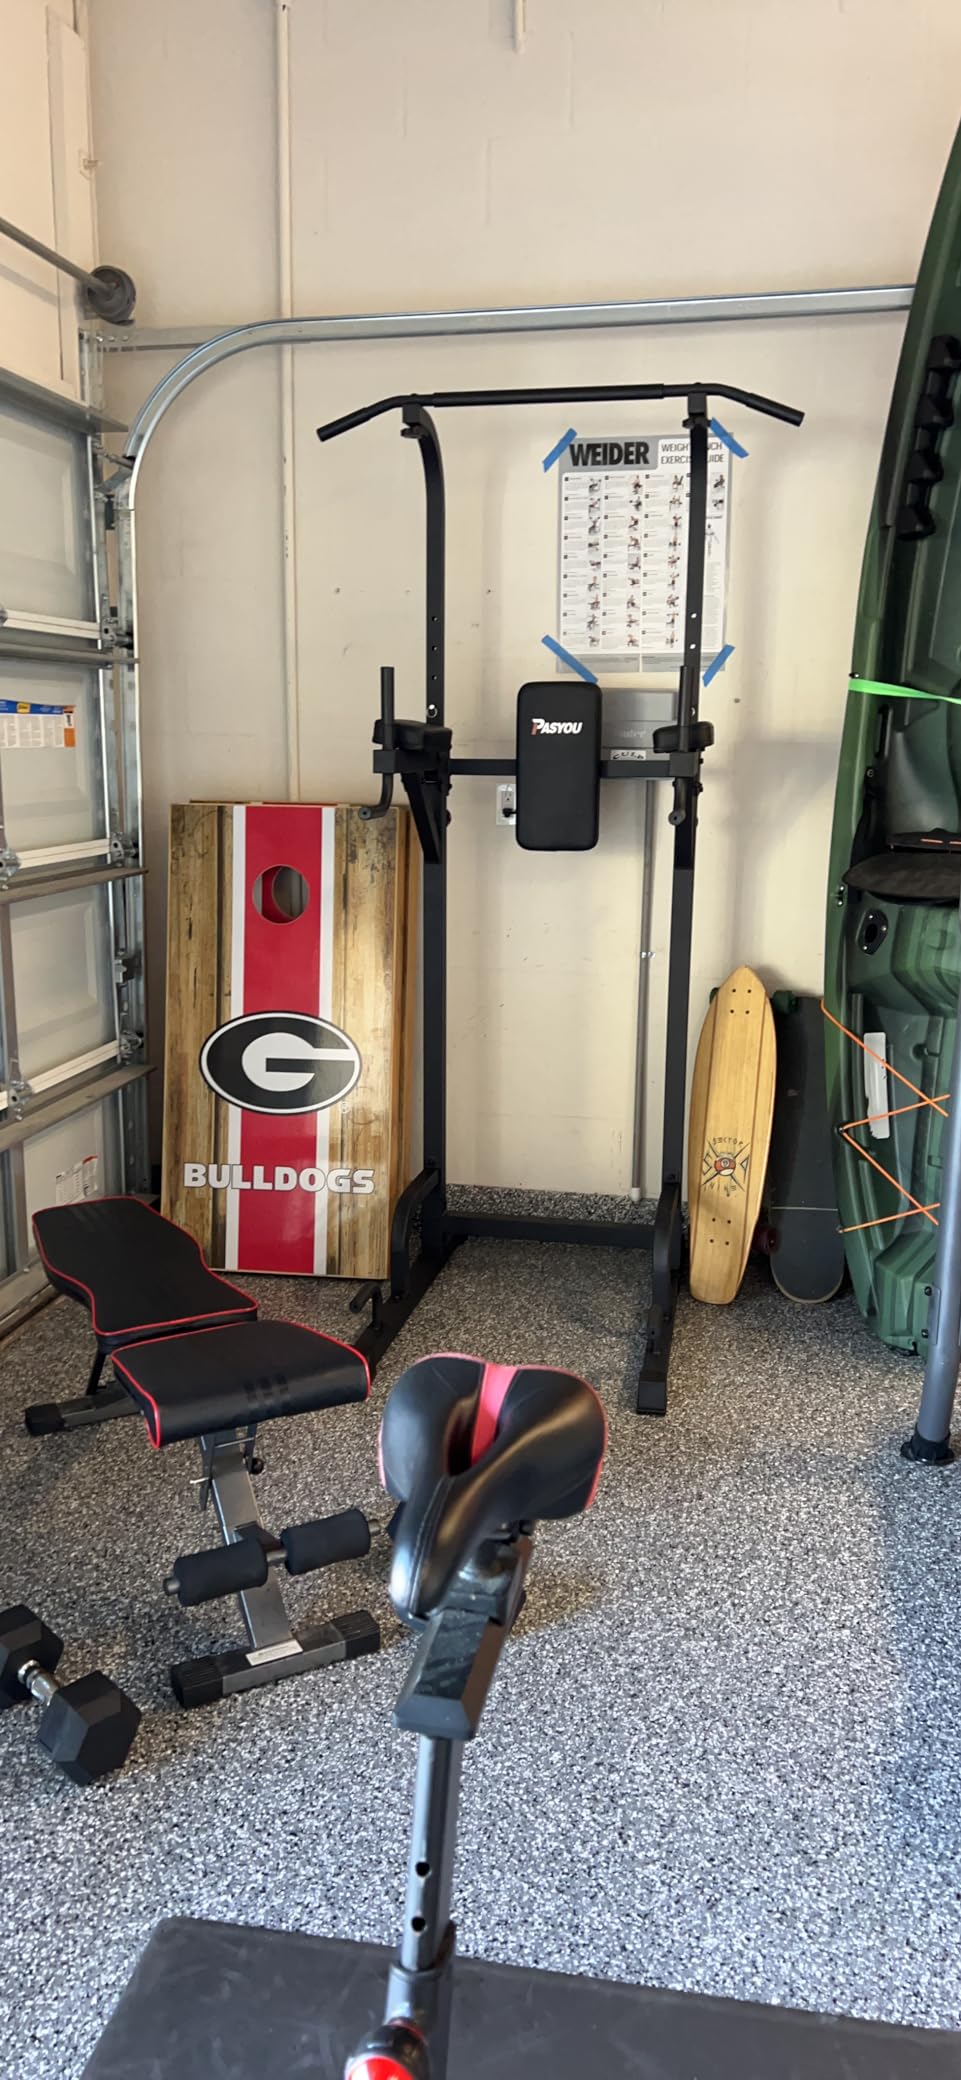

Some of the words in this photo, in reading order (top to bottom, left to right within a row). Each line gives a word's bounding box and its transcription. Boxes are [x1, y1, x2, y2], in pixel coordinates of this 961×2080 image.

[569, 441, 650, 466] WEIDER
[661, 443, 690, 452] WEIGH
[707, 454, 724, 463] UIDE
[531, 718, 583, 735] PASYOU
[201, 1012, 360, 1113] G
[183, 1162, 375, 1194] BULLDOGS
